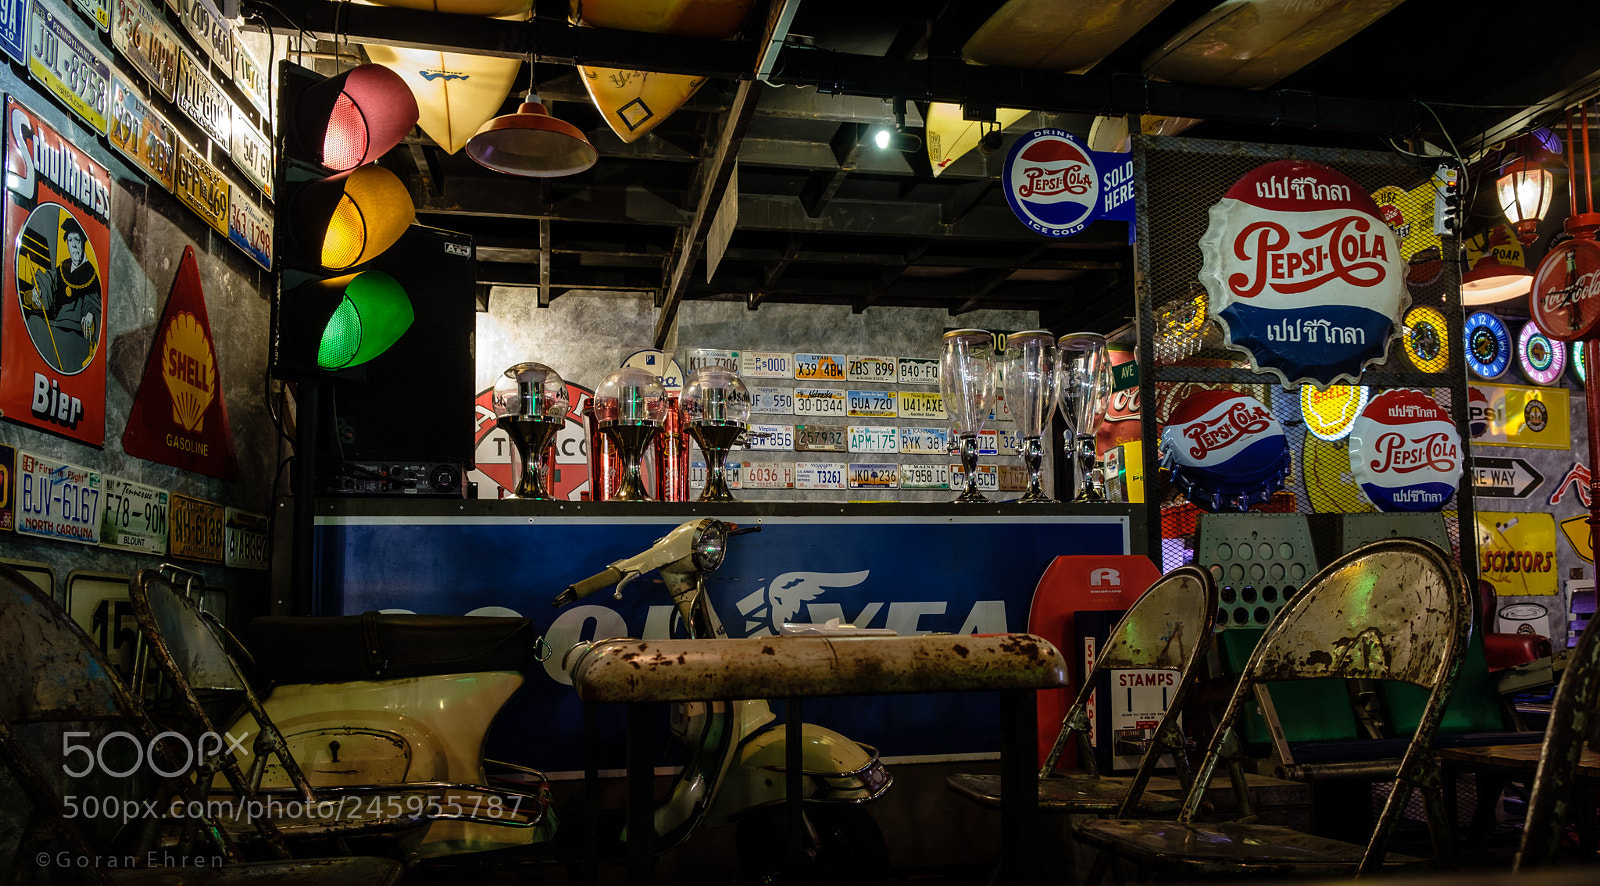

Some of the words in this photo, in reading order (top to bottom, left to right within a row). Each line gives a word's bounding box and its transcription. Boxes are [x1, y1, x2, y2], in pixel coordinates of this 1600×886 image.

[52, 21, 93, 63] PENNSYLVANIA
[1033, 129, 1075, 141] DRINK
[243, 132, 259, 171] 547
[11, 106, 110, 220] Schultheiss
[180, 153, 200, 197] GPP
[1103, 160, 1134, 192] SOLD
[1104, 179, 1135, 213] HERE
[230, 203, 247, 238] 363
[250, 220, 271, 259] 1298
[1028, 220, 1048, 234] ICE
[1052, 223, 1085, 236] COLD
[1491, 247, 1520, 261] ROAR
[168, 348, 211, 392] SHELL
[798, 362, 817, 376] X39
[849, 360, 869, 376] ZBS
[875, 362, 894, 376] 899
[1121, 364, 1135, 380] AVE
[31, 371, 83, 428] Bier
[773, 394, 792, 407] 550
[851, 397, 870, 410] GUA
[873, 397, 893, 410] 720
[166, 433, 209, 457] GASOLINE
[902, 436, 921, 450] RYK
[749, 468, 778, 482] 6036
[879, 469, 896, 482] 236
[909, 469, 933, 483] 7958
[1490, 470, 1516, 486] WAY
[122, 482, 153, 500] Tennessee
[25, 518, 54, 533] NORTH
[56, 524, 93, 539] CAROLINA
[123, 537, 146, 547] BLOUNT
[1481, 550, 1554, 573] SCISSORS
[1119, 673, 1174, 687] STAMPS
